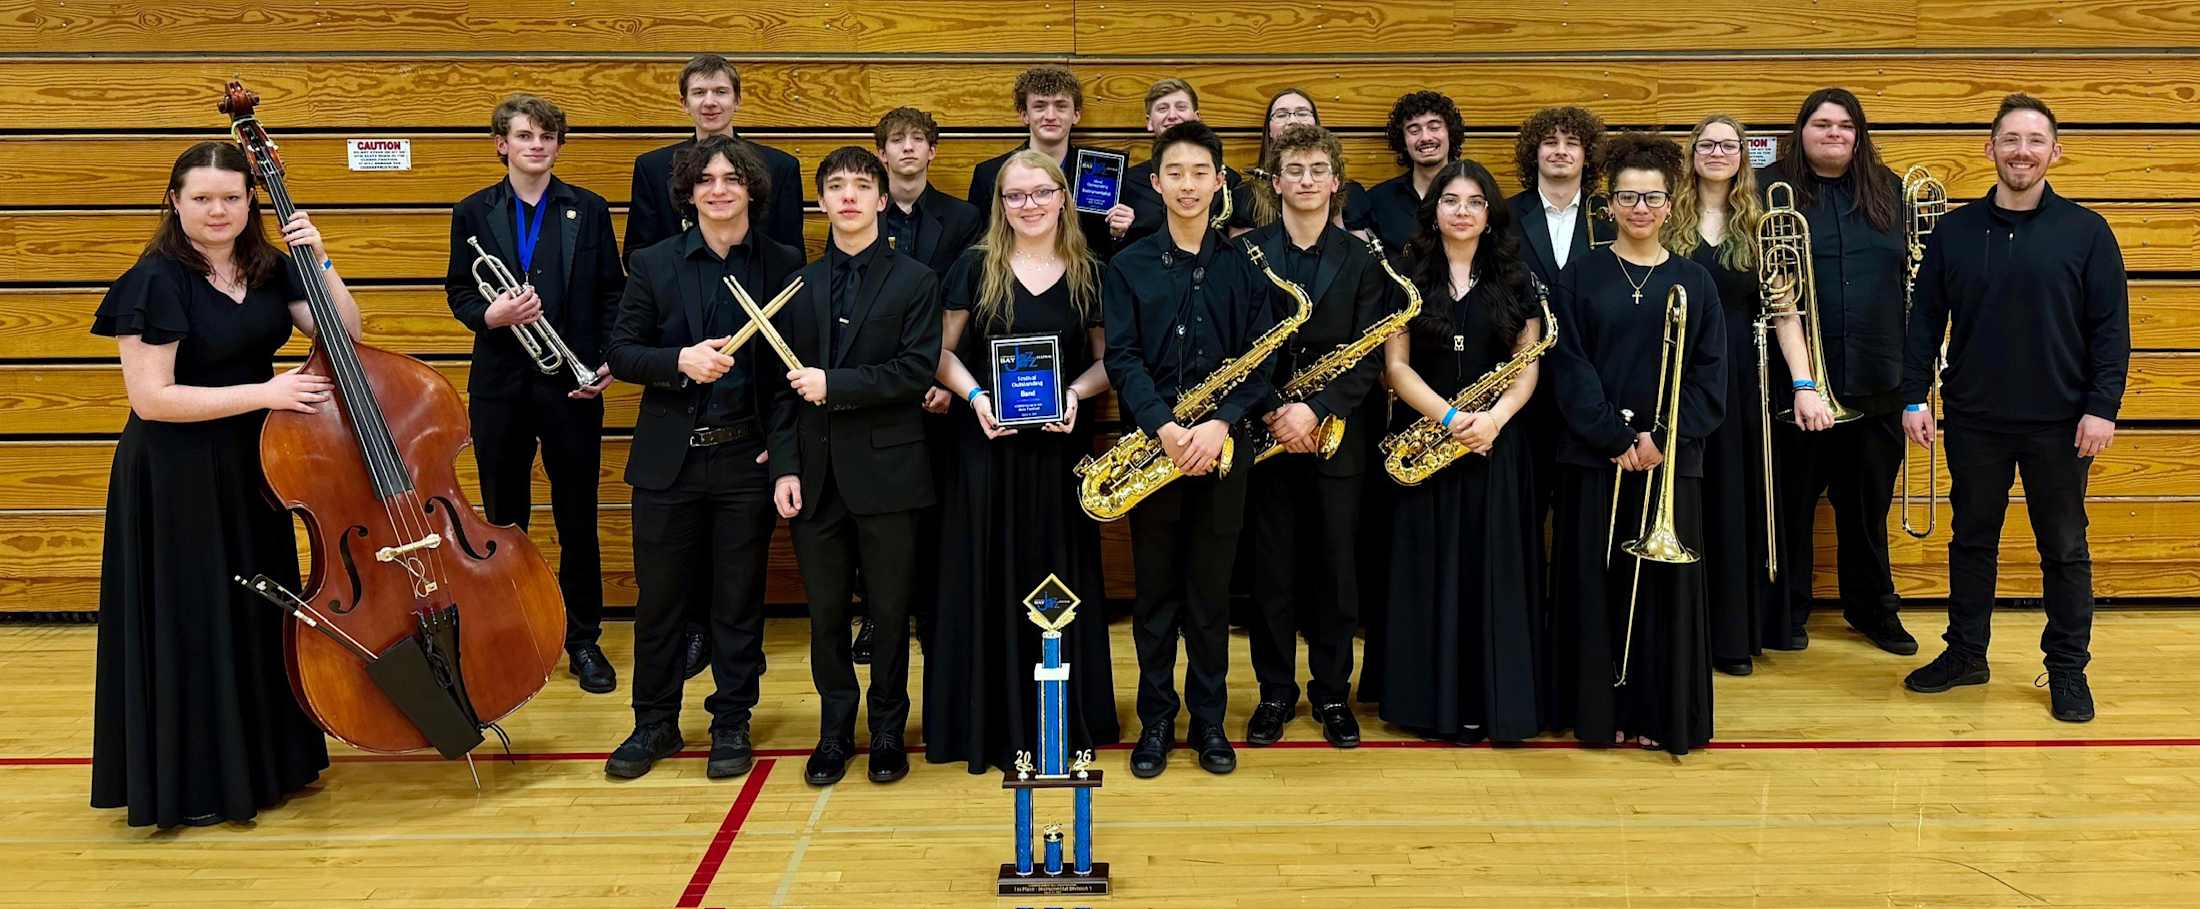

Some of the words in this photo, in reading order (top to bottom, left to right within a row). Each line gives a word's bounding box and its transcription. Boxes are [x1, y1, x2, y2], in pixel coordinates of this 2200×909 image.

[357, 141, 401, 150] CAUTION
[1011, 380, 1043, 388] Outstanding
[1014, 749, 1031, 765] 20
[1073, 749, 1092, 767] 26
